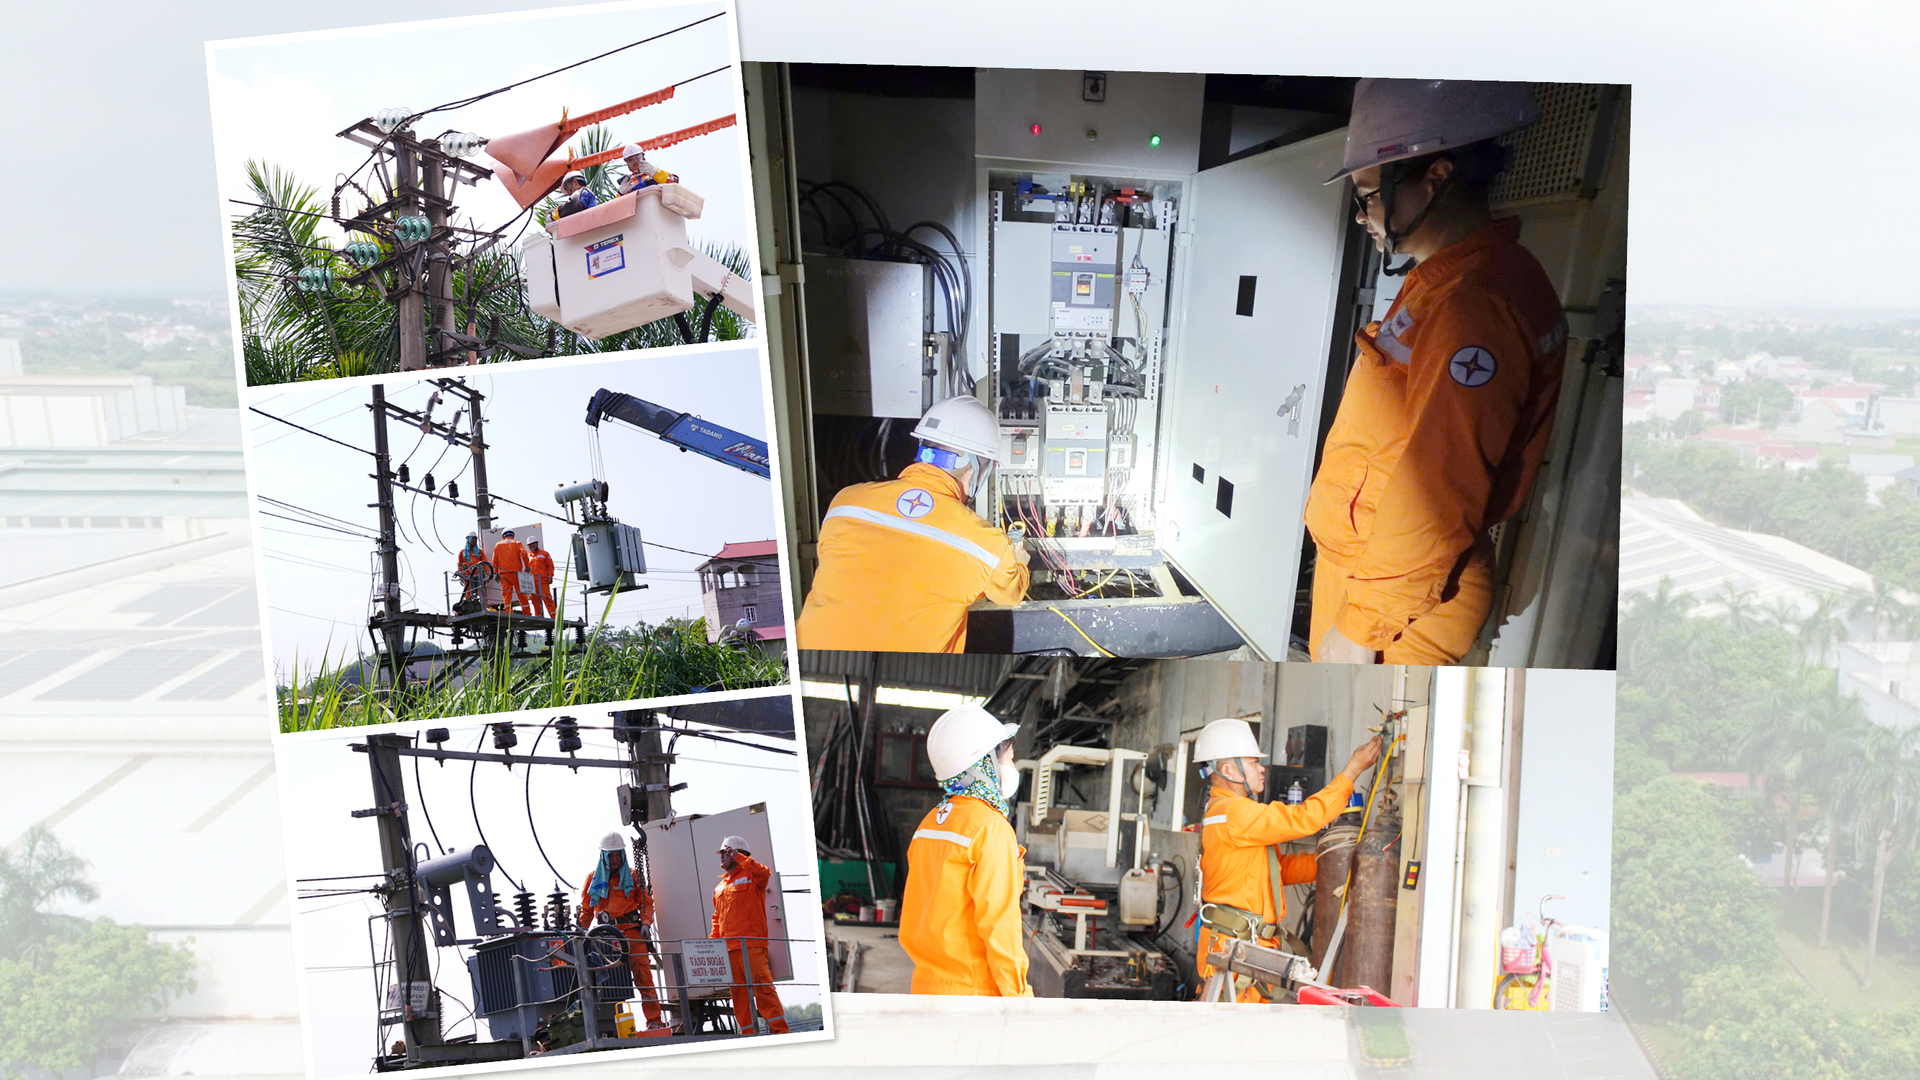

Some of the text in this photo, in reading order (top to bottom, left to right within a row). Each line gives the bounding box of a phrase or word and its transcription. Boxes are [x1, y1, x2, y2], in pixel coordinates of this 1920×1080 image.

[699, 427, 723, 440] TADANO
[689, 954, 725, 966] VÀNG NGOÀI
